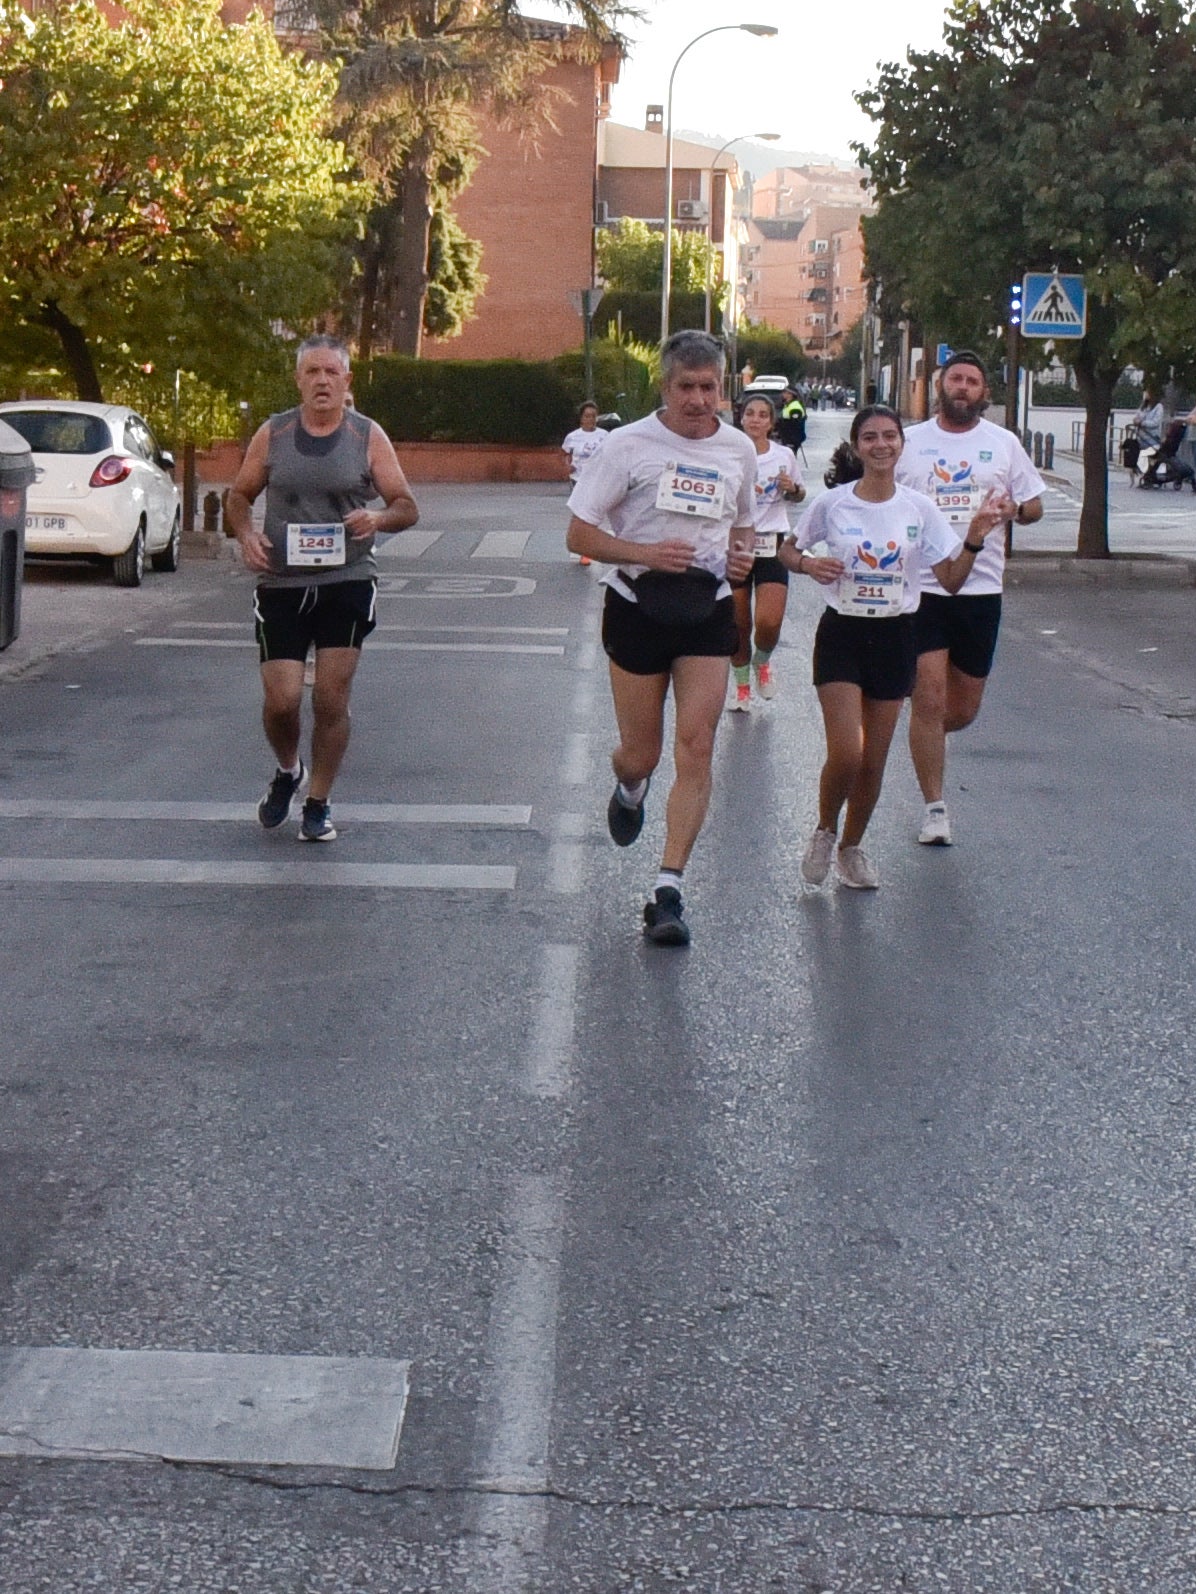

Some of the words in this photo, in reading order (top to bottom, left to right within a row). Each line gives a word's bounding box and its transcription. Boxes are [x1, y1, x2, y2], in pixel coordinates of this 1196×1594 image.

[671, 478, 716, 496] 1063
[935, 495, 971, 507] 1399
[43, 517, 66, 529] GPB
[298, 537, 334, 548] 1243
[857, 585, 885, 598] 211
